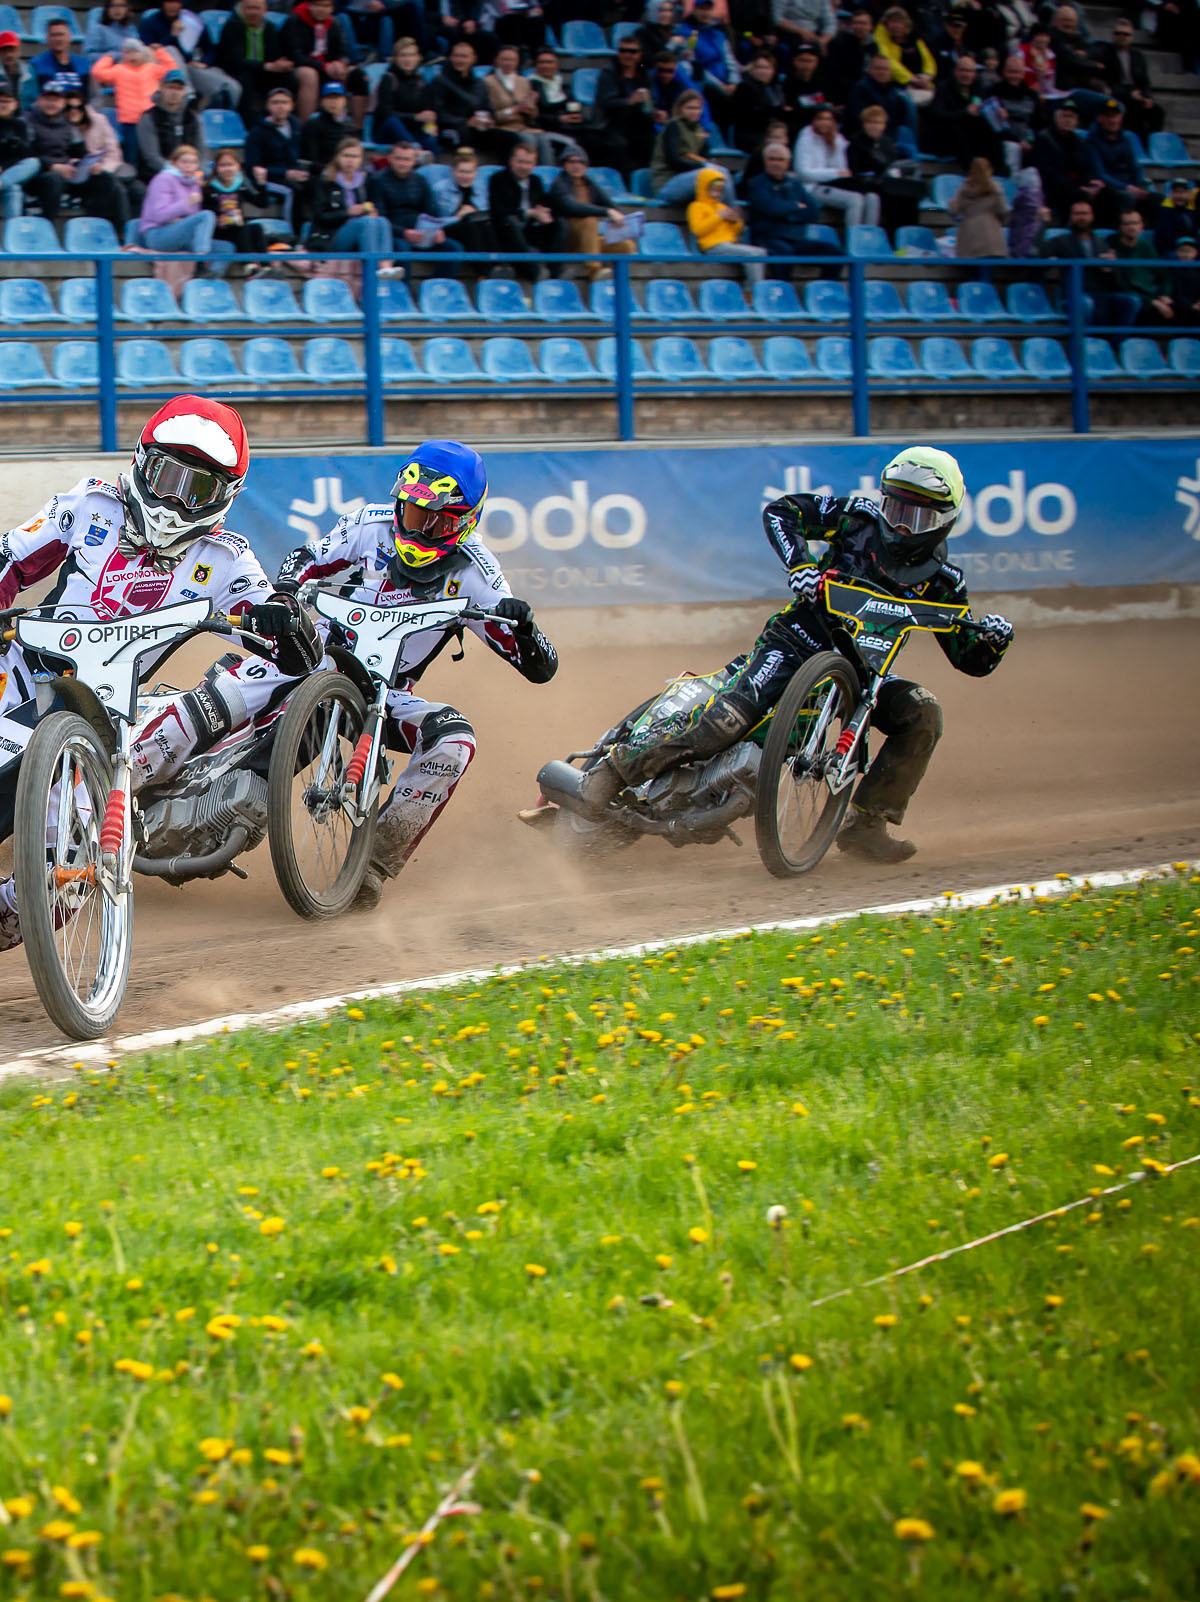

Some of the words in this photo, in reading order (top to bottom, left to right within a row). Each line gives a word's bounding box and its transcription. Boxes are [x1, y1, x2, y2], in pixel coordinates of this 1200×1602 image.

[367, 509, 394, 517] TRO
[370, 610, 428, 626] OPTIBET
[87, 625, 163, 644] OPTIBET
[436, 711, 466, 724] FLAM
